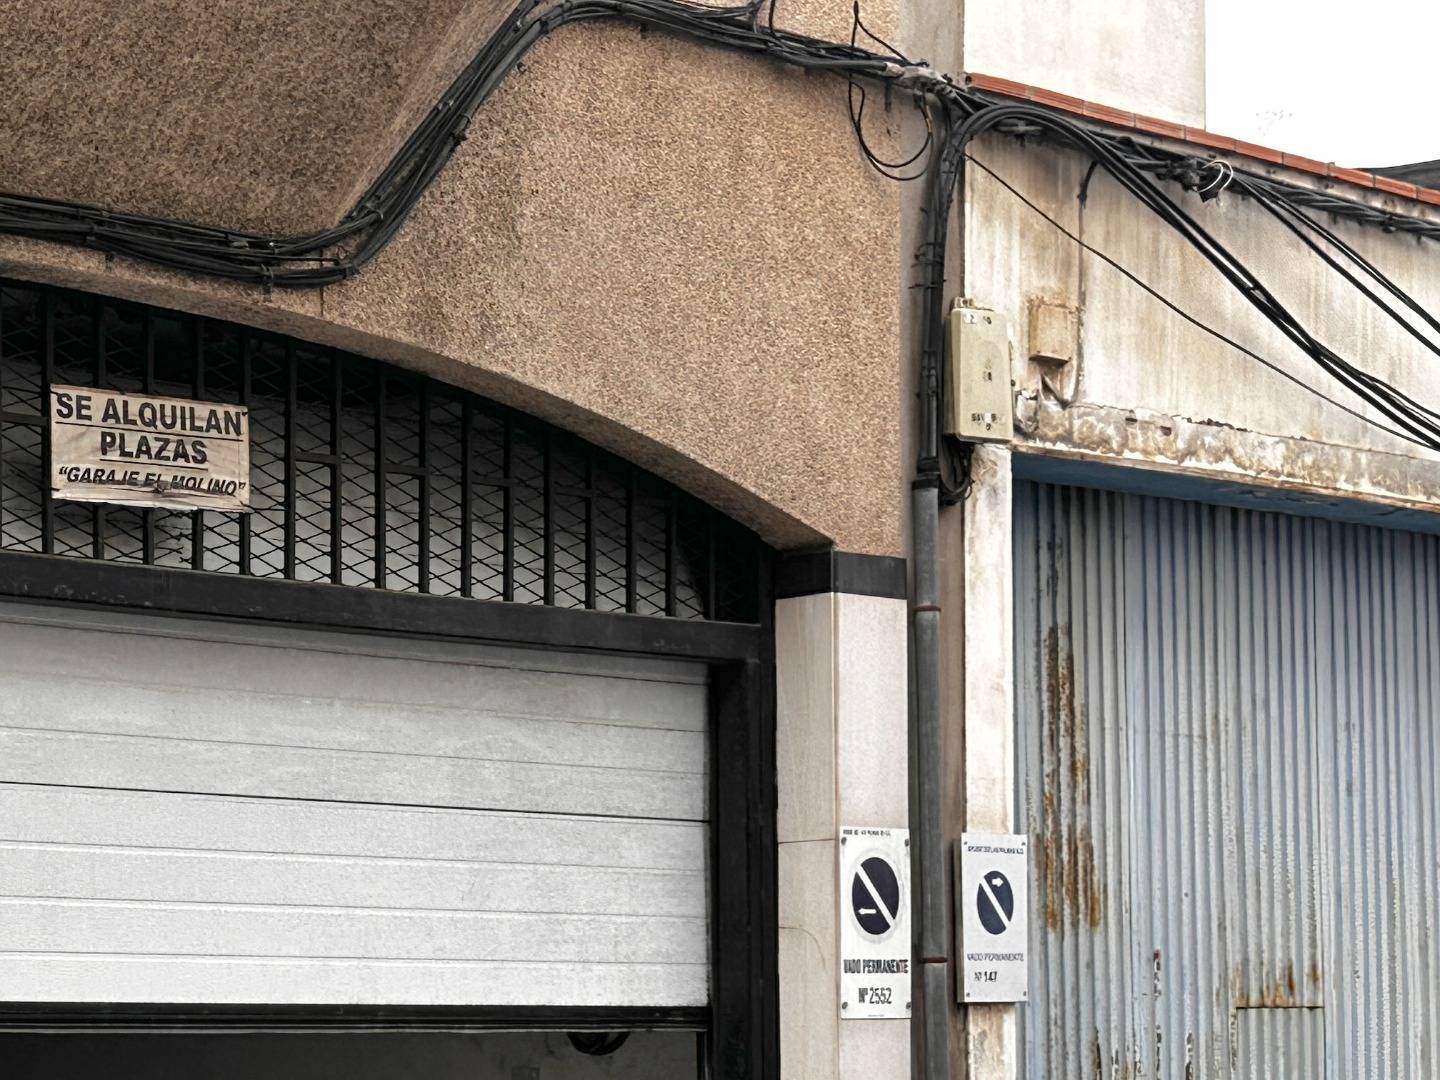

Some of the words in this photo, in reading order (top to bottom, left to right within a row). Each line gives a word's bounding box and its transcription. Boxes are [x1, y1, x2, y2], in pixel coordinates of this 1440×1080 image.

[56, 393, 92, 421] SE
[101, 398, 241, 436] ALQUILAN
[100, 431, 208, 464] PLAZAS
